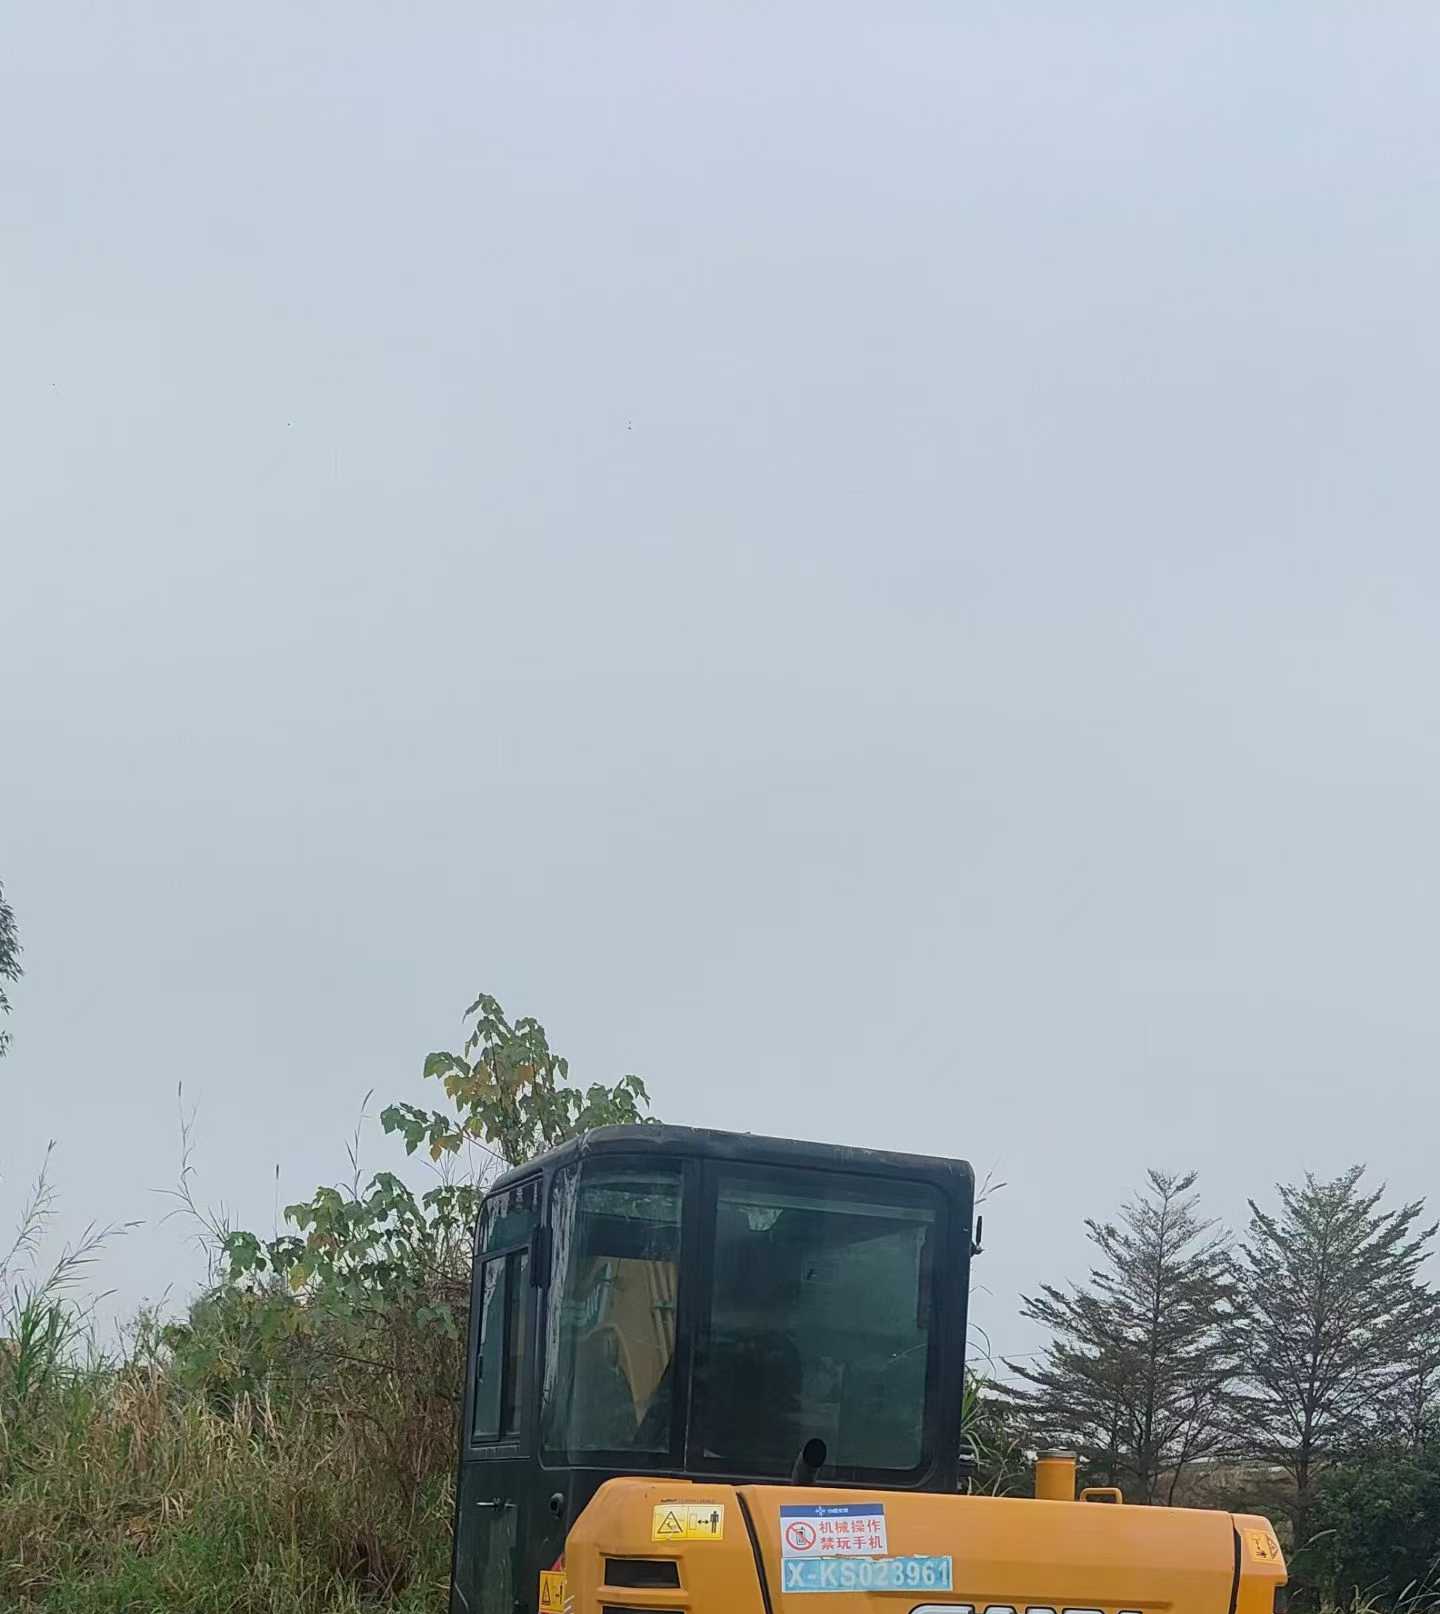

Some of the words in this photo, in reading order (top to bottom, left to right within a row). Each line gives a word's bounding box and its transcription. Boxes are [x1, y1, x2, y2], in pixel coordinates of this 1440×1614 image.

[819, 1519, 881, 1534] 机械操作
[820, 1536, 883, 1550] 禁玩手机
